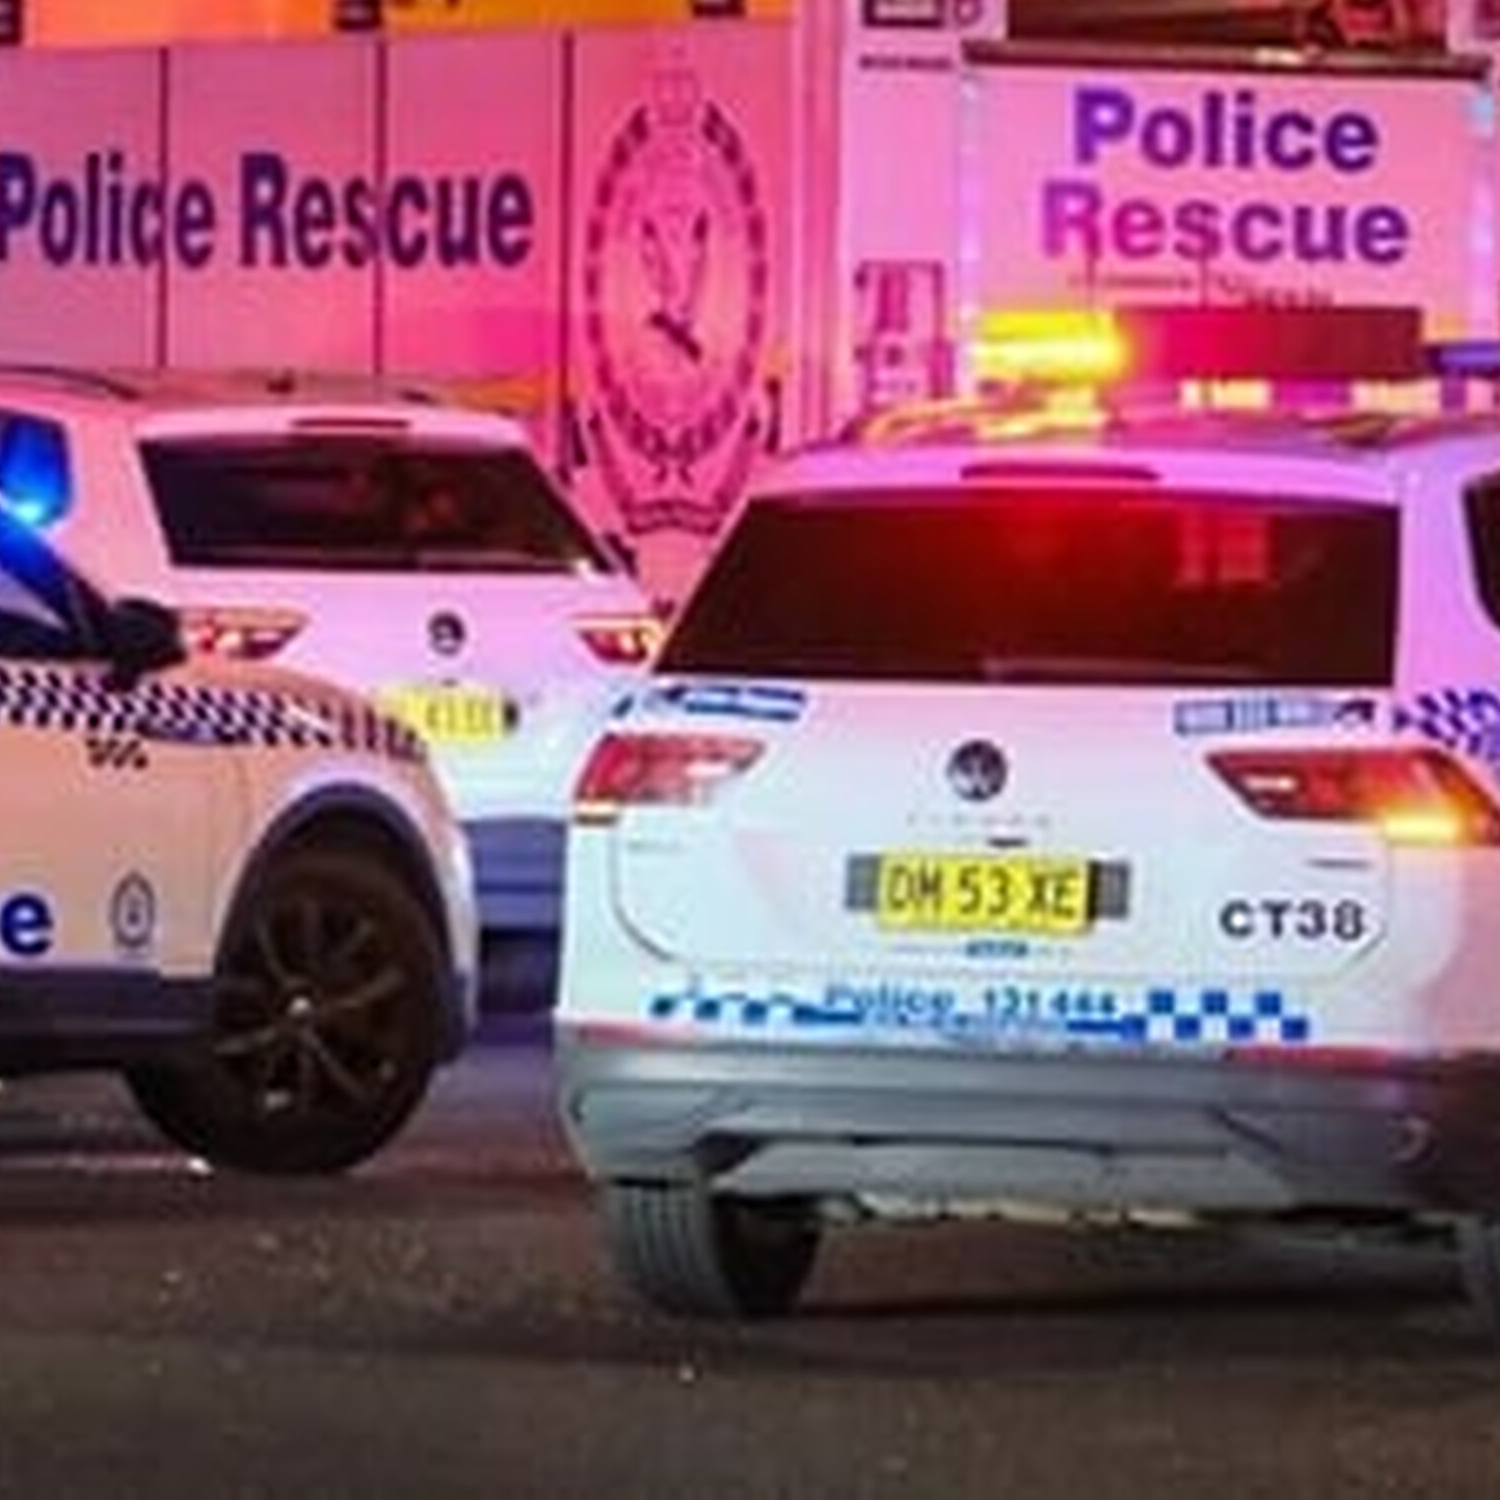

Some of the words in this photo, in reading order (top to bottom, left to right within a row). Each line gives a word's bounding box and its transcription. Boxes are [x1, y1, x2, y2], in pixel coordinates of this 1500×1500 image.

[1074, 89, 1380, 171] Police
[240, 151, 535, 268] Rescue
[1043, 180, 1411, 264] Rescue
[888, 864, 943, 912] DM
[958, 866, 1011, 916] 53
[1024, 870, 1079, 919] XE
[1220, 900, 1366, 940] CT38
